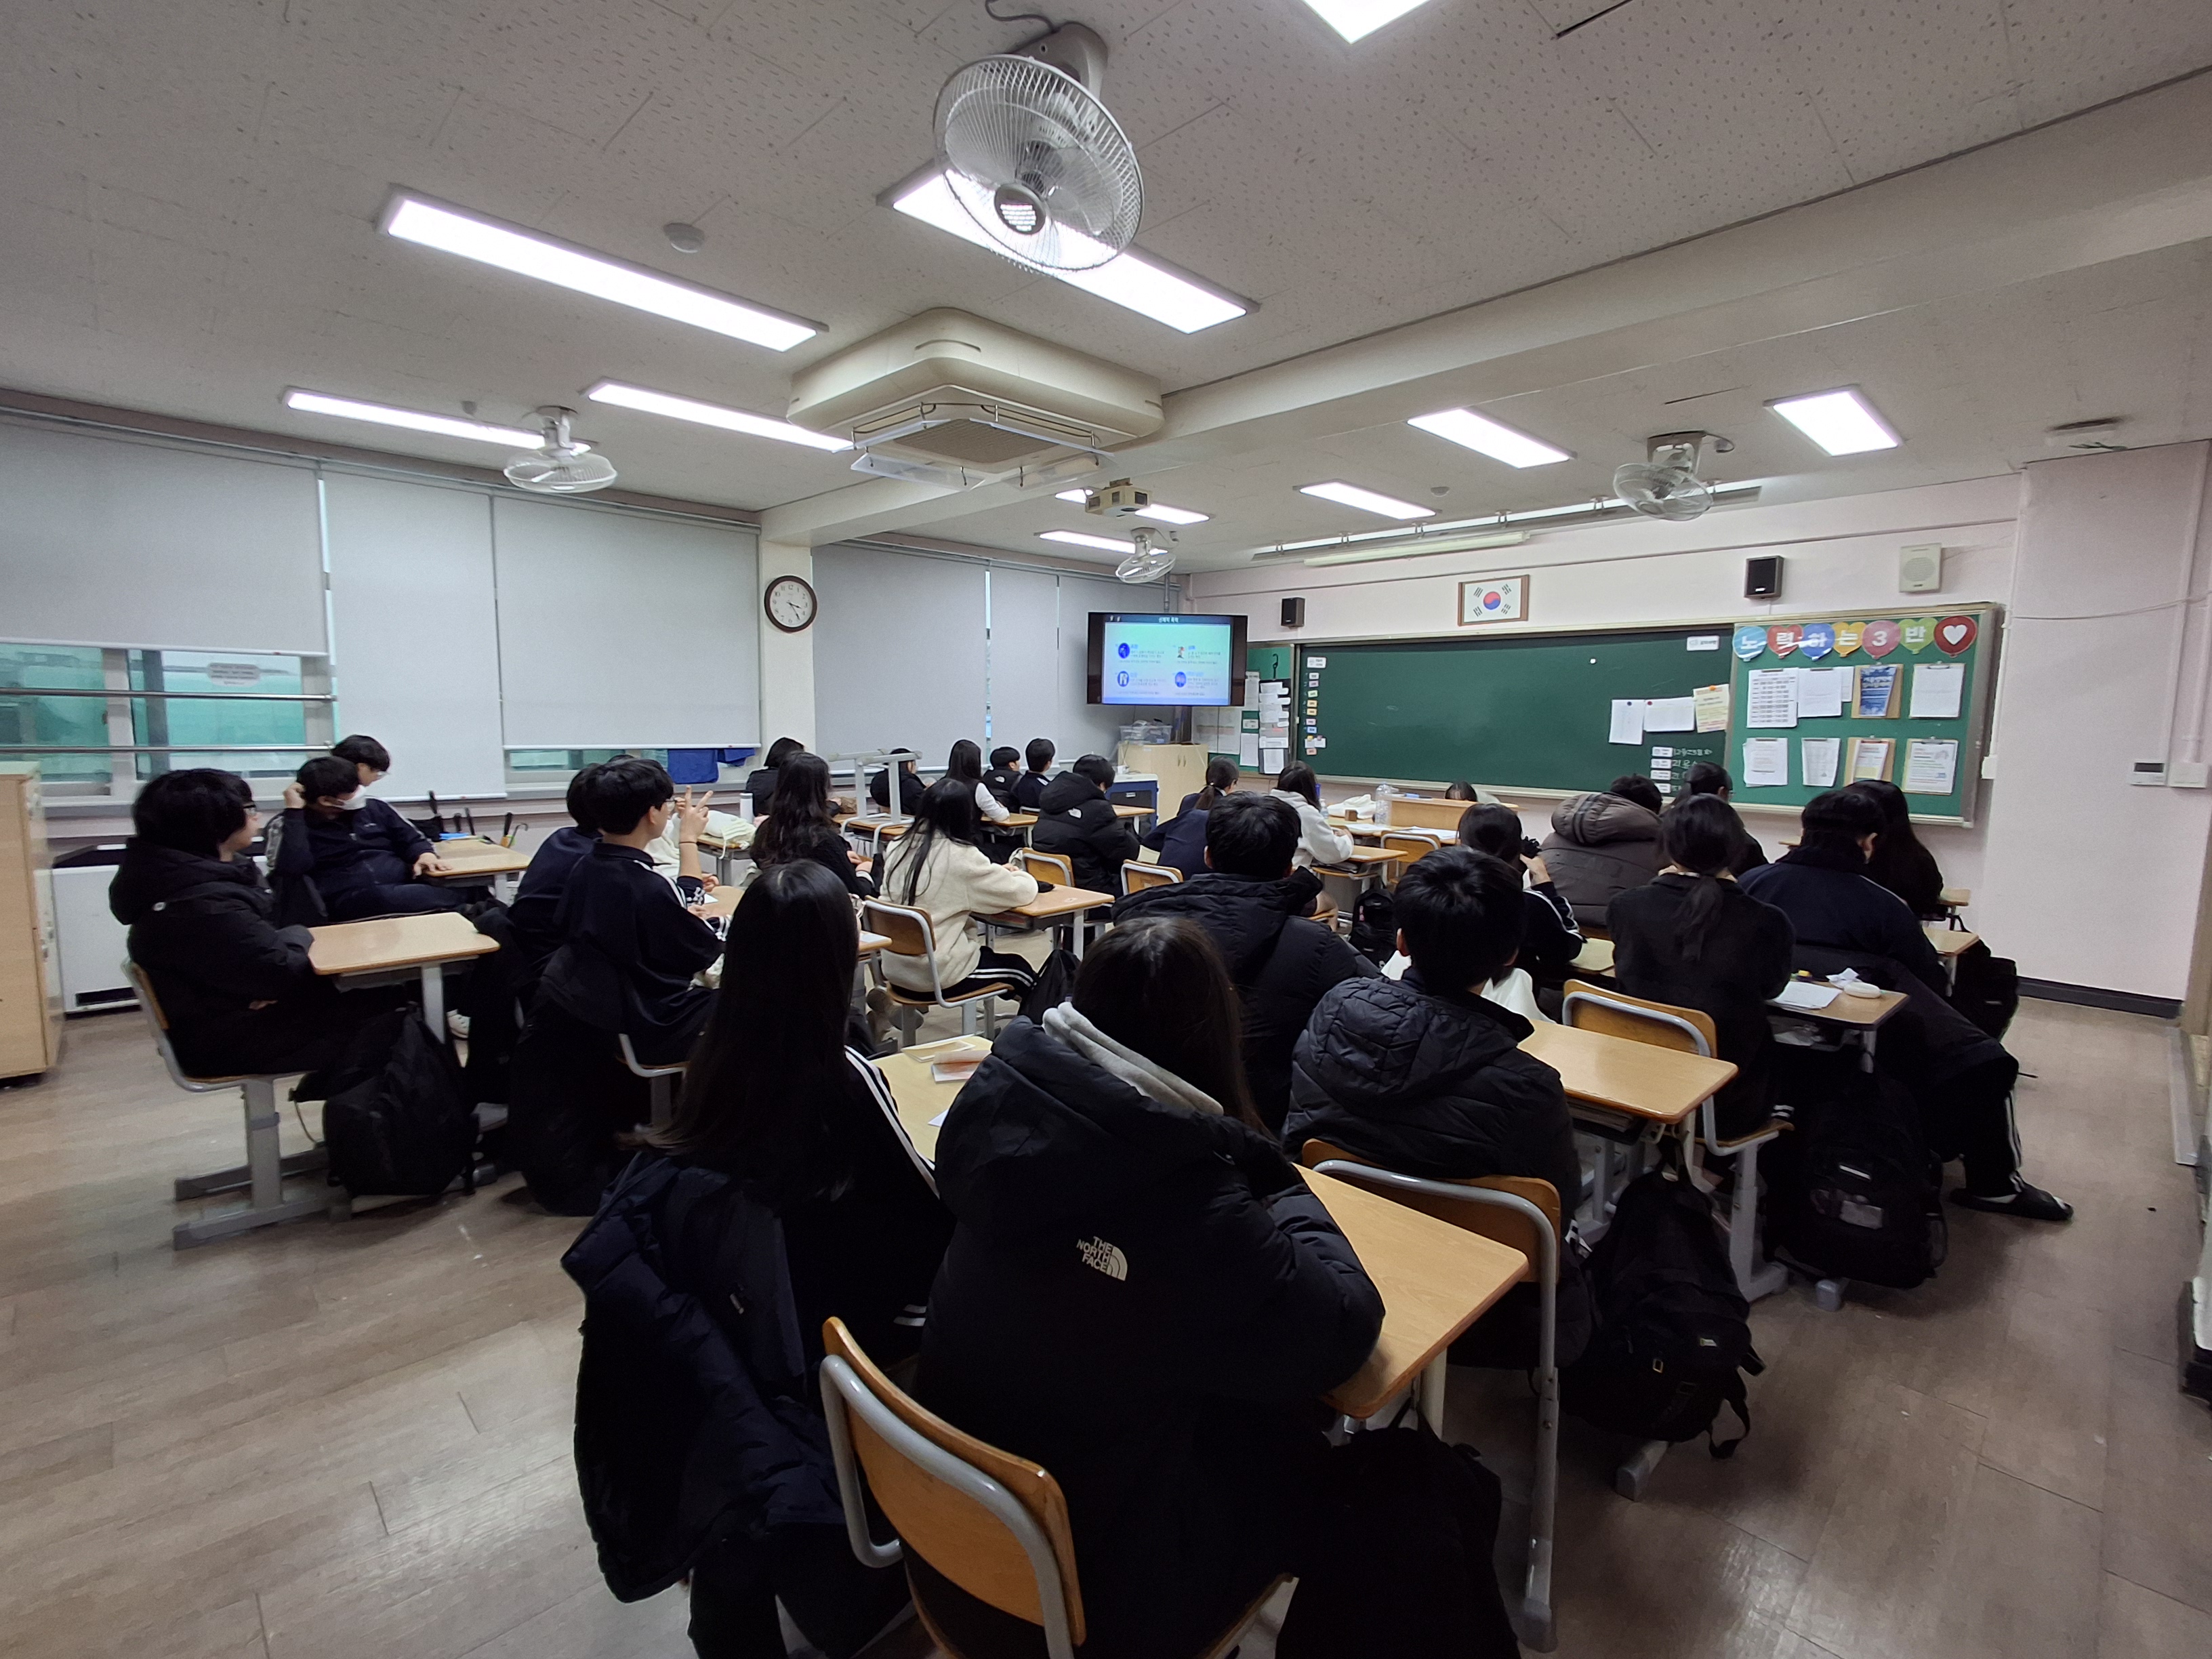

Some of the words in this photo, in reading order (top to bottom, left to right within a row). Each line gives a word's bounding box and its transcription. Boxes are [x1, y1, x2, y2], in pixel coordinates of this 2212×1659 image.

[1740, 630, 1857, 651] 노력하는
[1872, 626, 1927, 647] 3반
[1076, 1239, 1111, 1264] NORTH
[1092, 1235, 1113, 1254] THE
[1082, 1252, 1107, 1273] FACE
